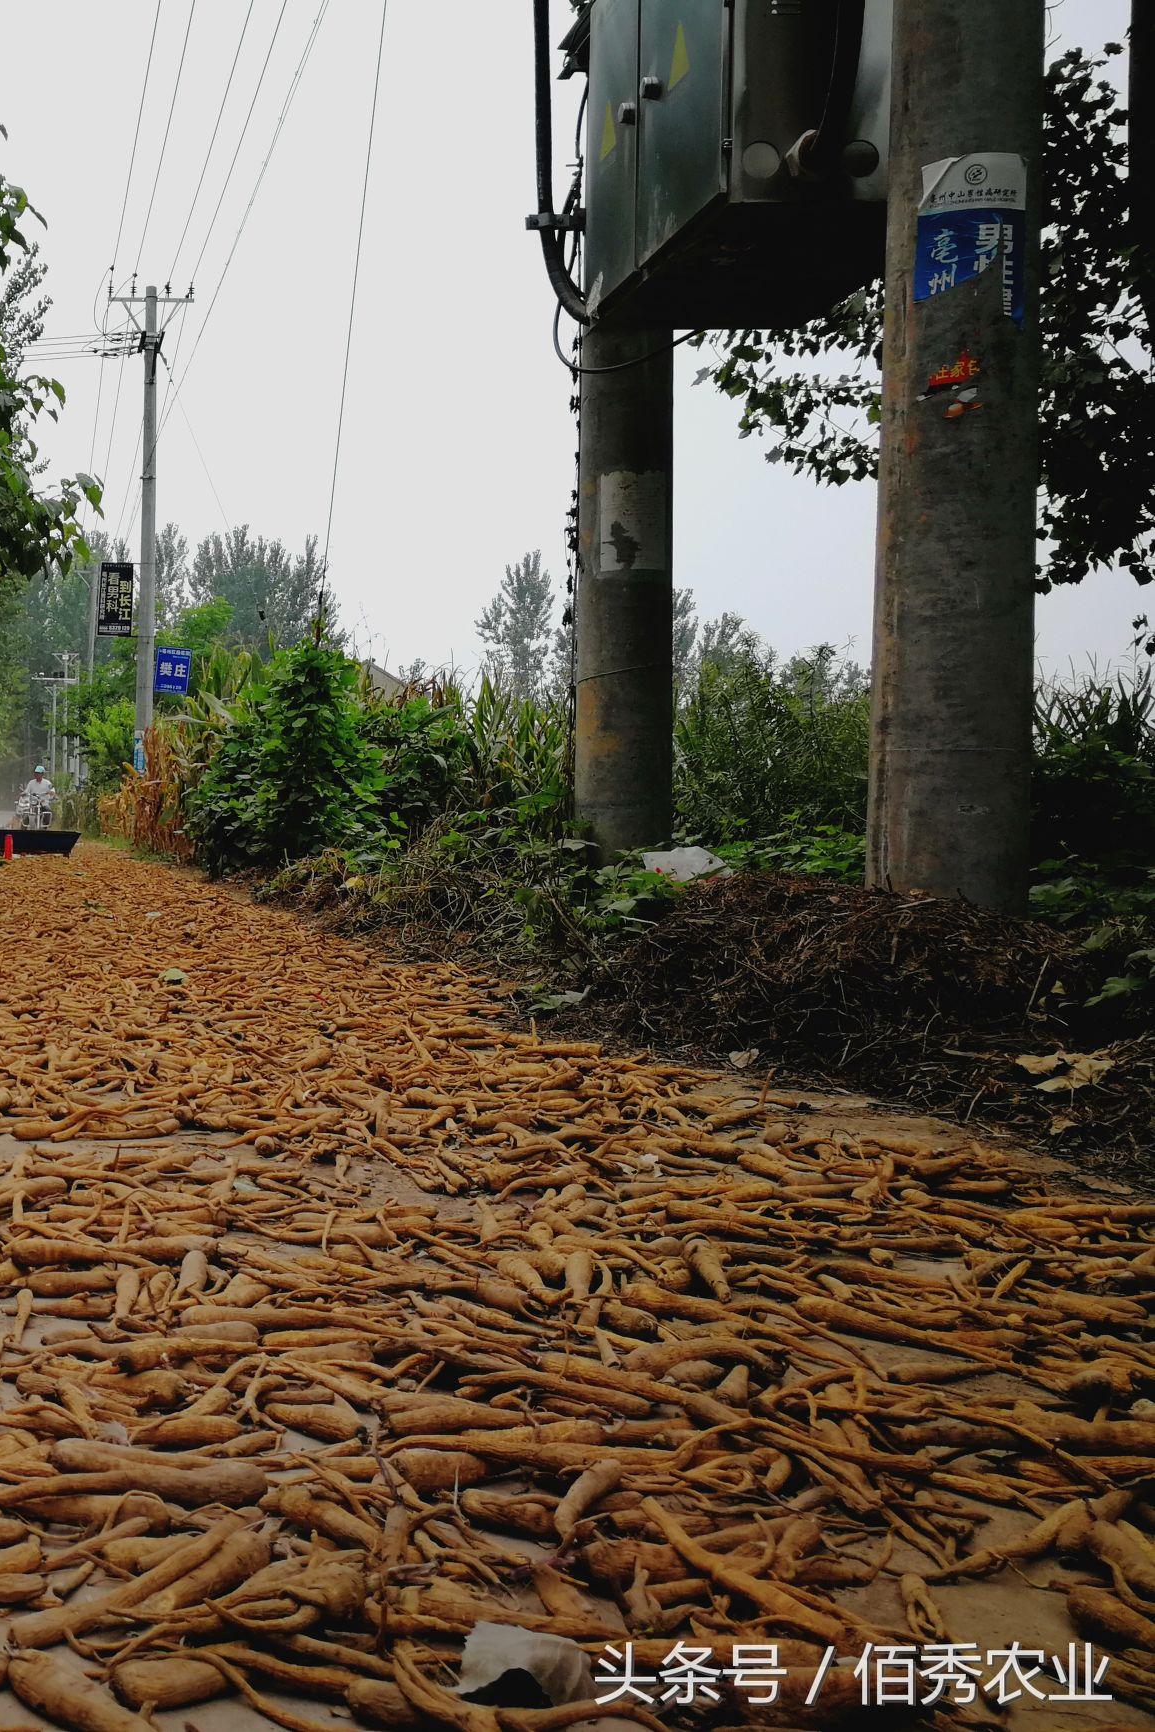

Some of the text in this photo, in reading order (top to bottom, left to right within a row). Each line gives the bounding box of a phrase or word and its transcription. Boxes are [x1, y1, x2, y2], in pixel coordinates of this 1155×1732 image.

[106, 572, 120, 613] 看男科
[118, 580, 132, 621] 到长江
[159, 661, 187, 678] 樊庄
